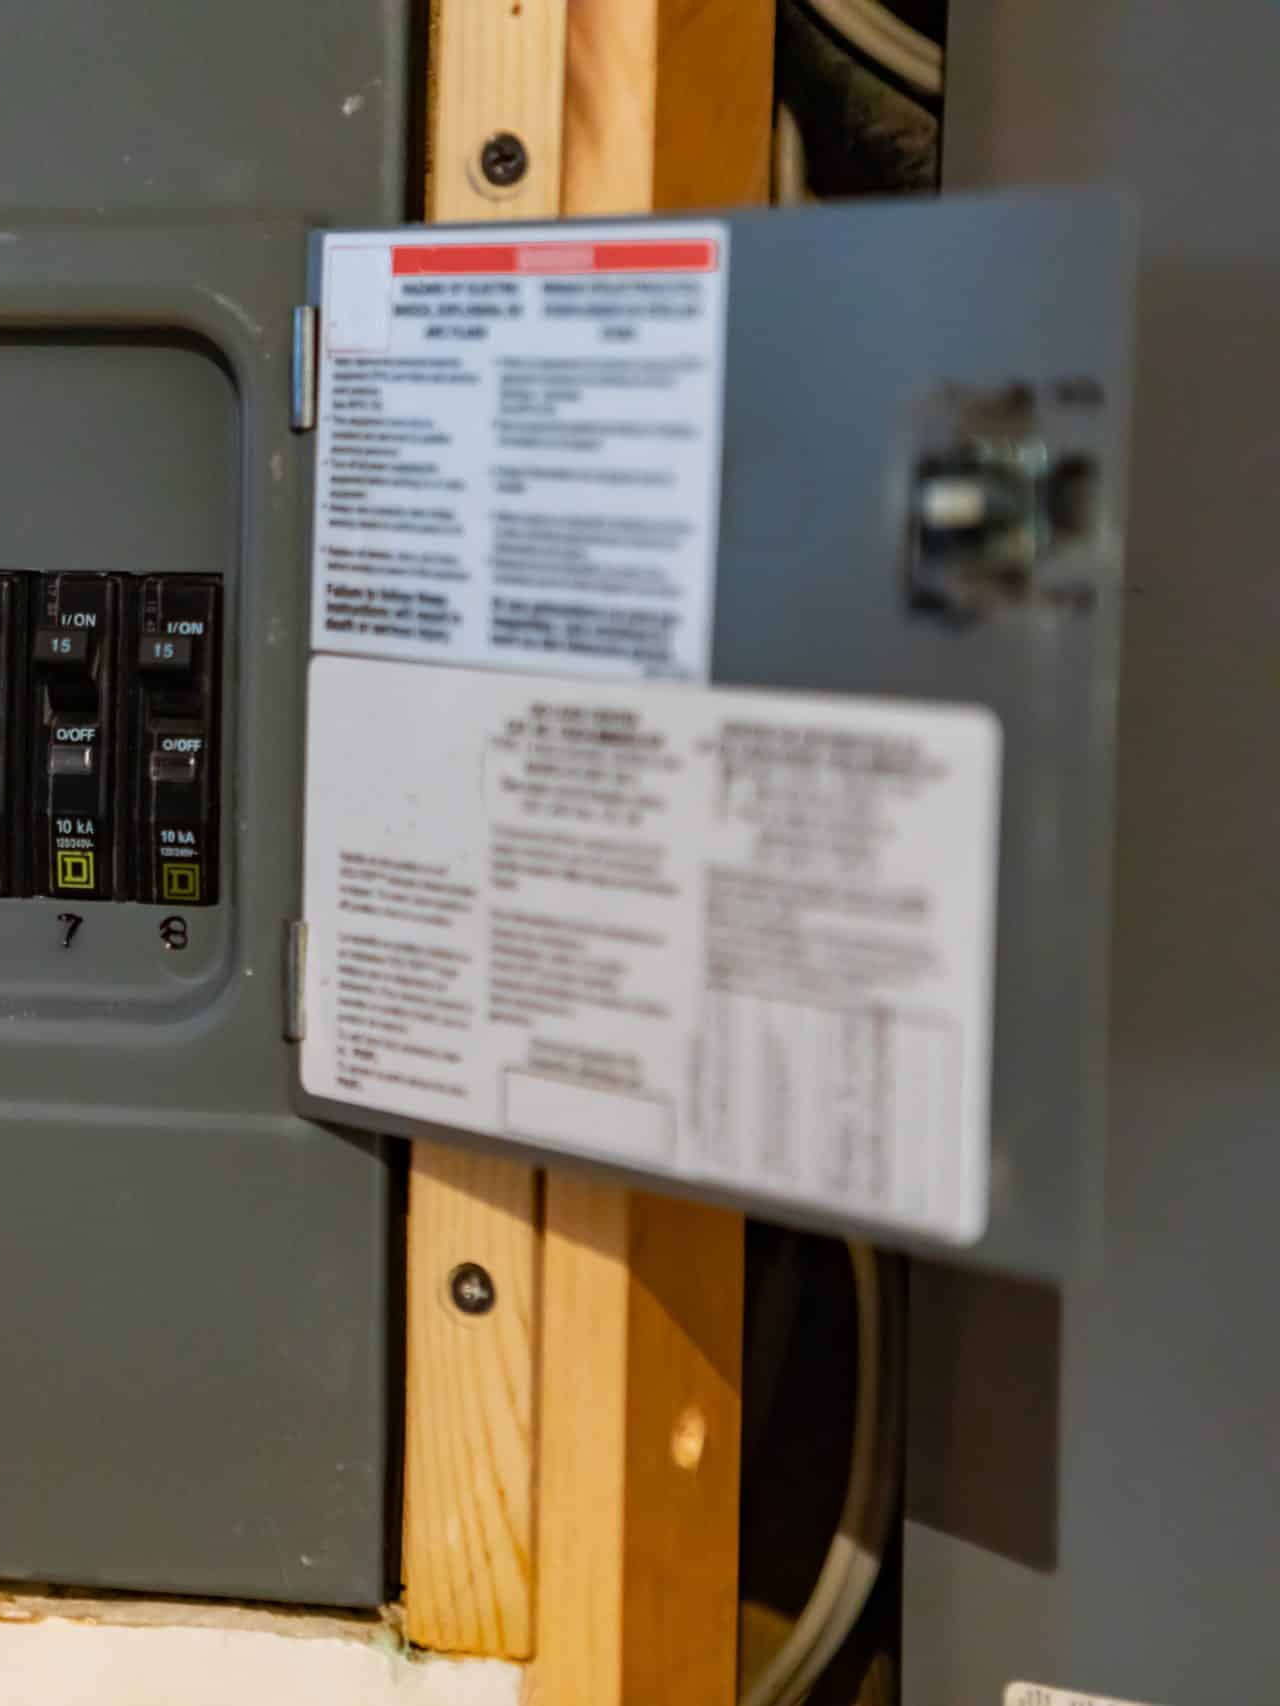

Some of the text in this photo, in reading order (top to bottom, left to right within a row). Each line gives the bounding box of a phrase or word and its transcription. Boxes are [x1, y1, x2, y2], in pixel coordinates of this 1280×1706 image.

[52, 638, 72, 653] 15
[153, 642, 174, 658] 15
[56, 728, 96, 742] O/OFF
[162, 738, 202, 752] O/OFF
[56, 818, 95, 835] 10 kA
[160, 829, 175, 844] 10
[57, 912, 84, 948] 7
[159, 916, 188, 950] 8
